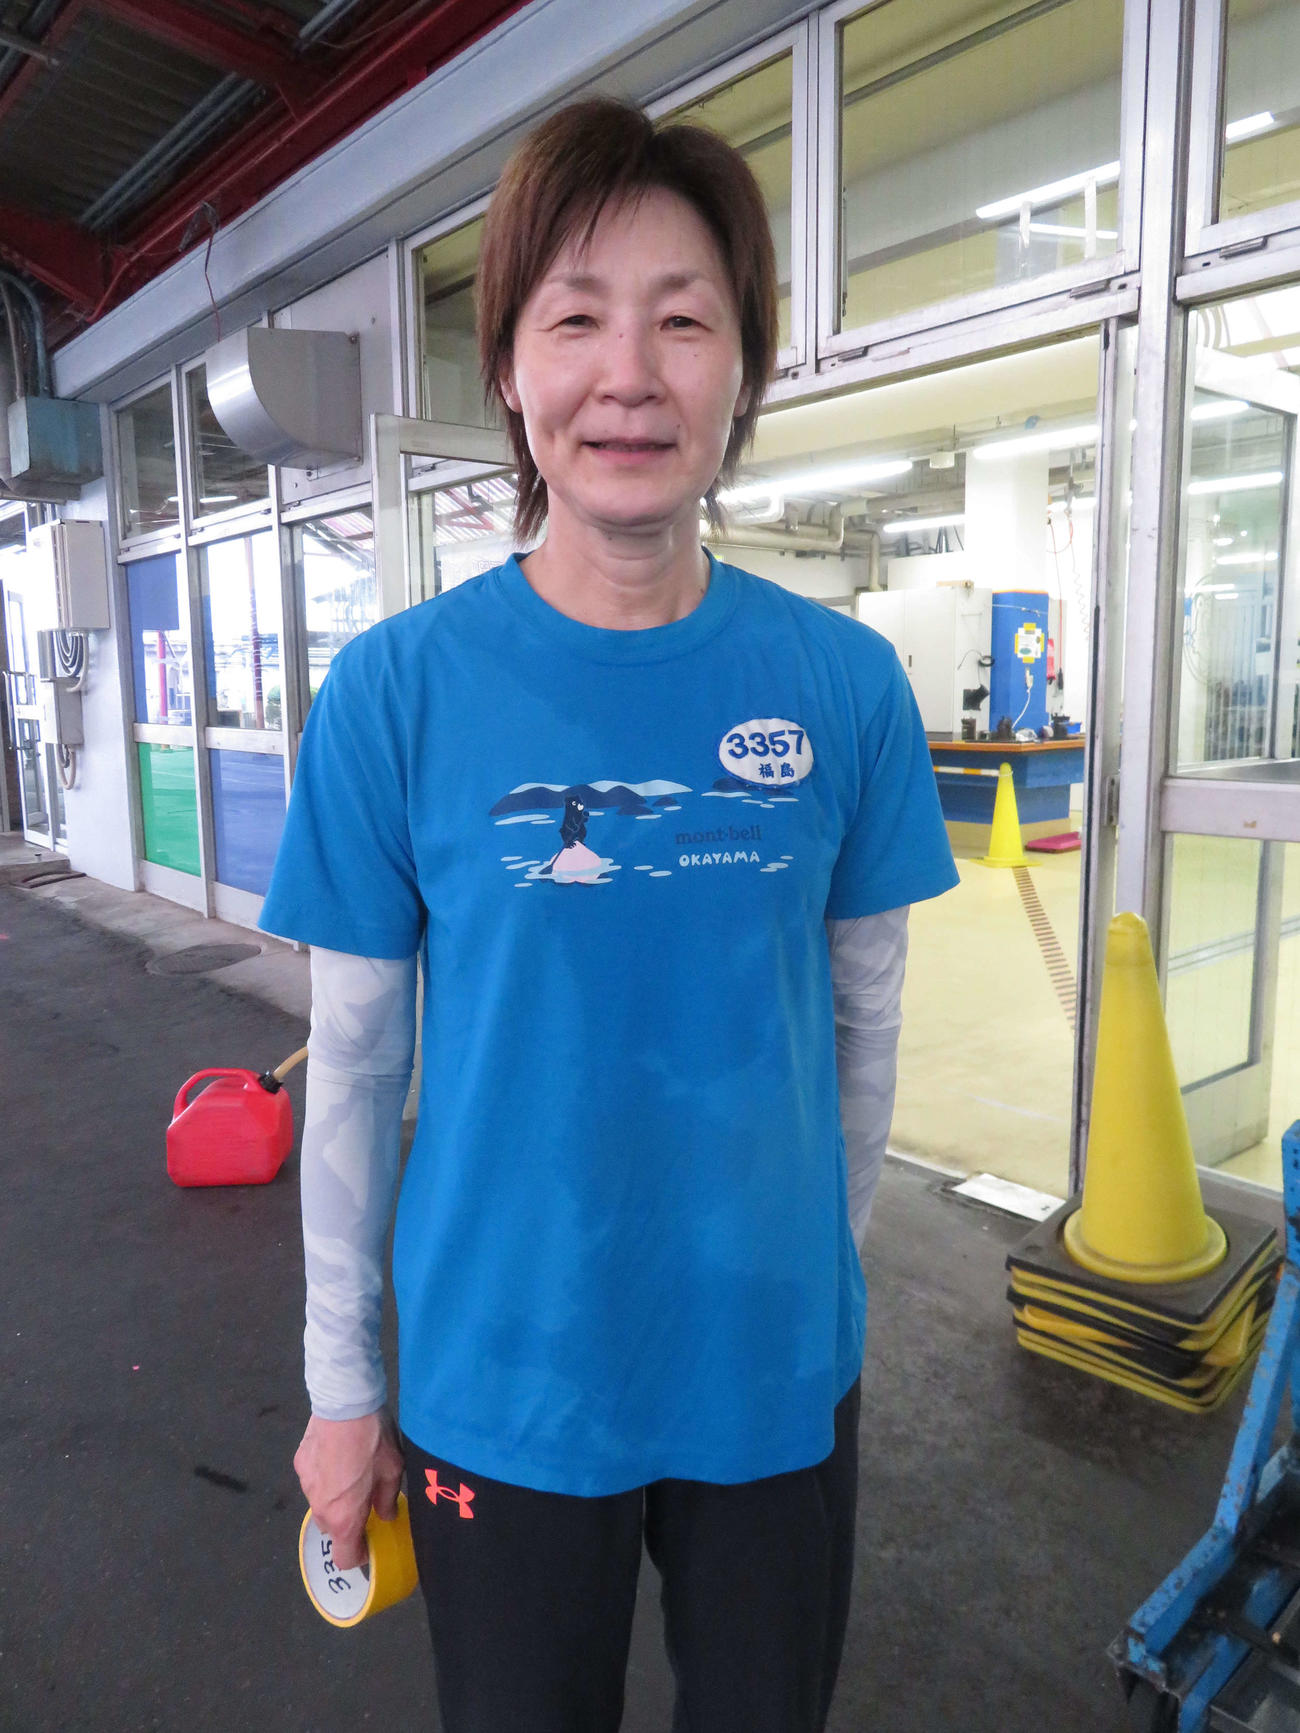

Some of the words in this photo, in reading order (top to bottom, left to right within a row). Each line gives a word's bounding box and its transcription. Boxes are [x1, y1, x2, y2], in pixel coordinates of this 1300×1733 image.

[726, 730, 804, 759] 3357
[758, 762, 795, 778] 福島
[678, 851, 760, 867] OKAYAMA
[320, 1532, 352, 1594] 335
